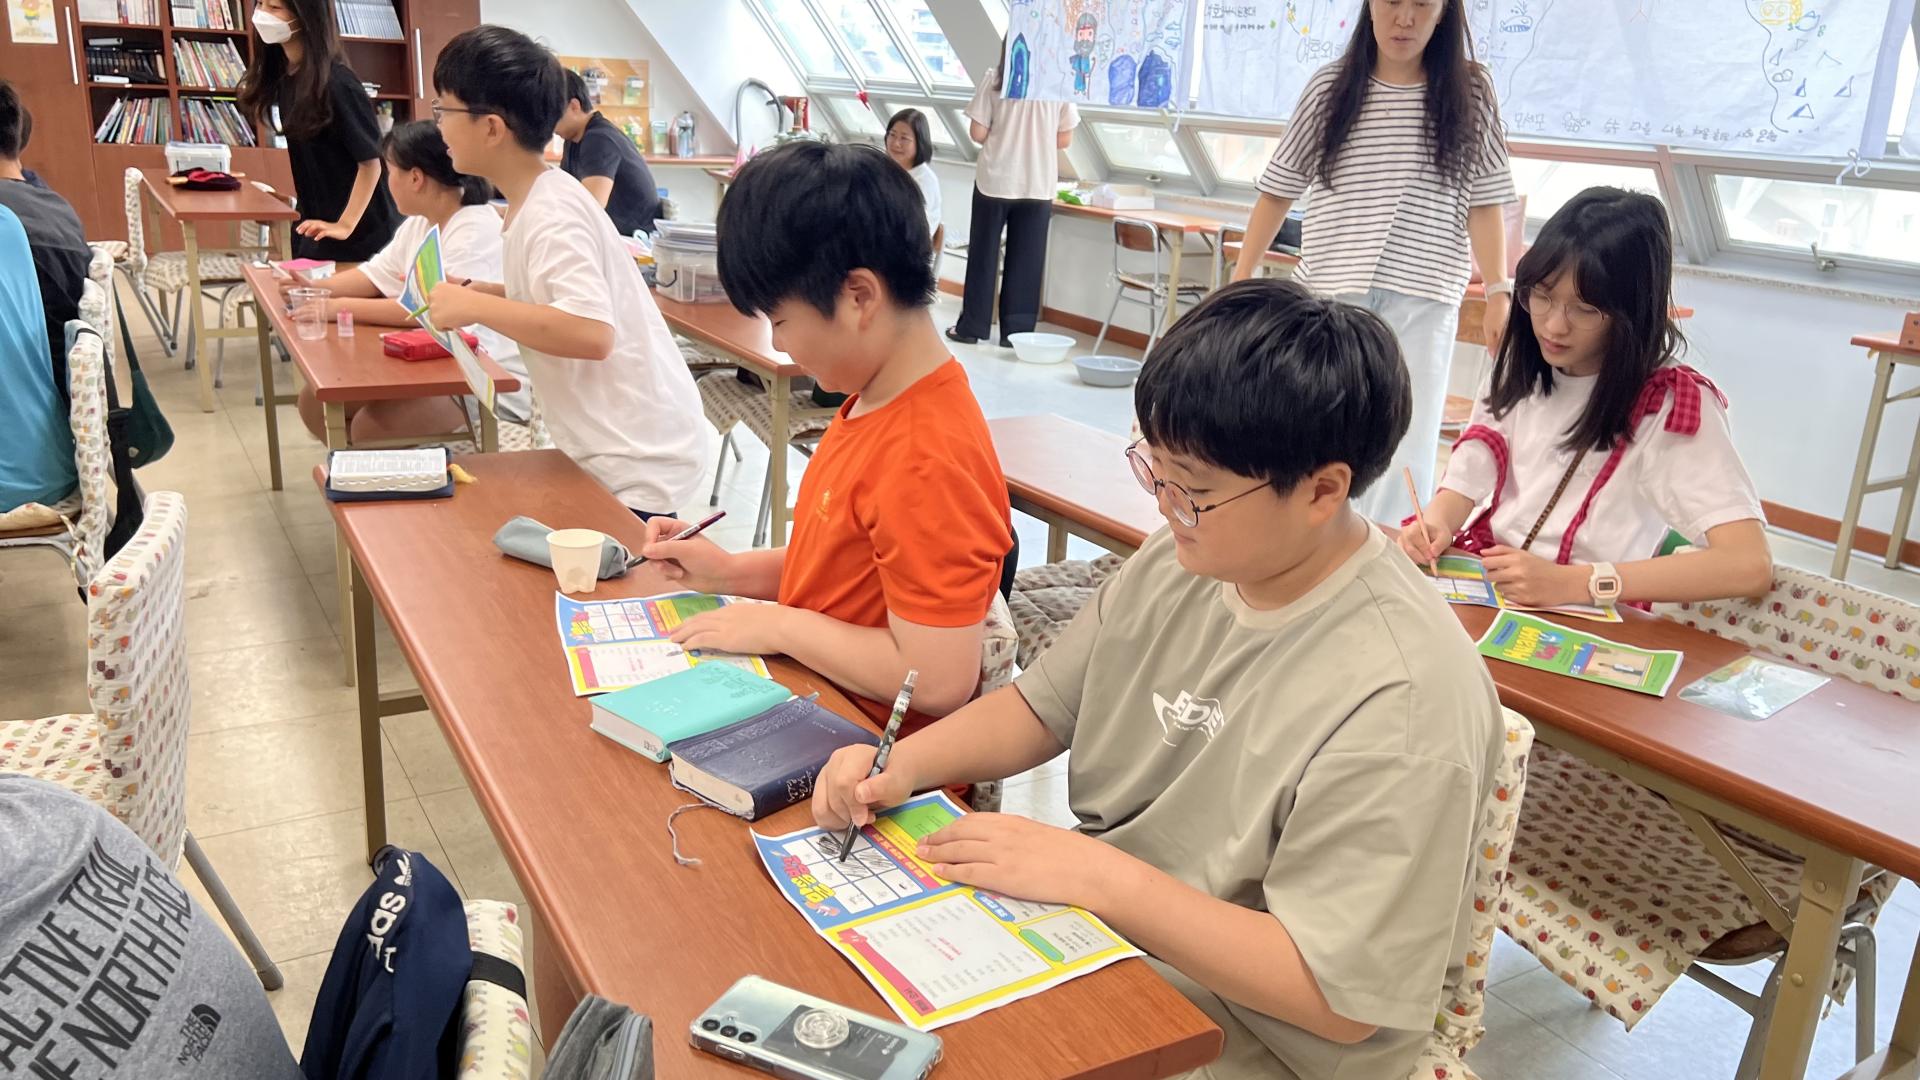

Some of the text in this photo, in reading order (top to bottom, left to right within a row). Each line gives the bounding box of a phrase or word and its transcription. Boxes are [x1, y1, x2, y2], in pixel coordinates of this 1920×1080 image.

[58, 837, 140, 933] TRAIL
[61, 855, 192, 1070] NORTH FACE
[177, 1021, 209, 1066] NORTH
[180, 1013, 199, 1038] THE
[192, 1029, 216, 1063] FACE
